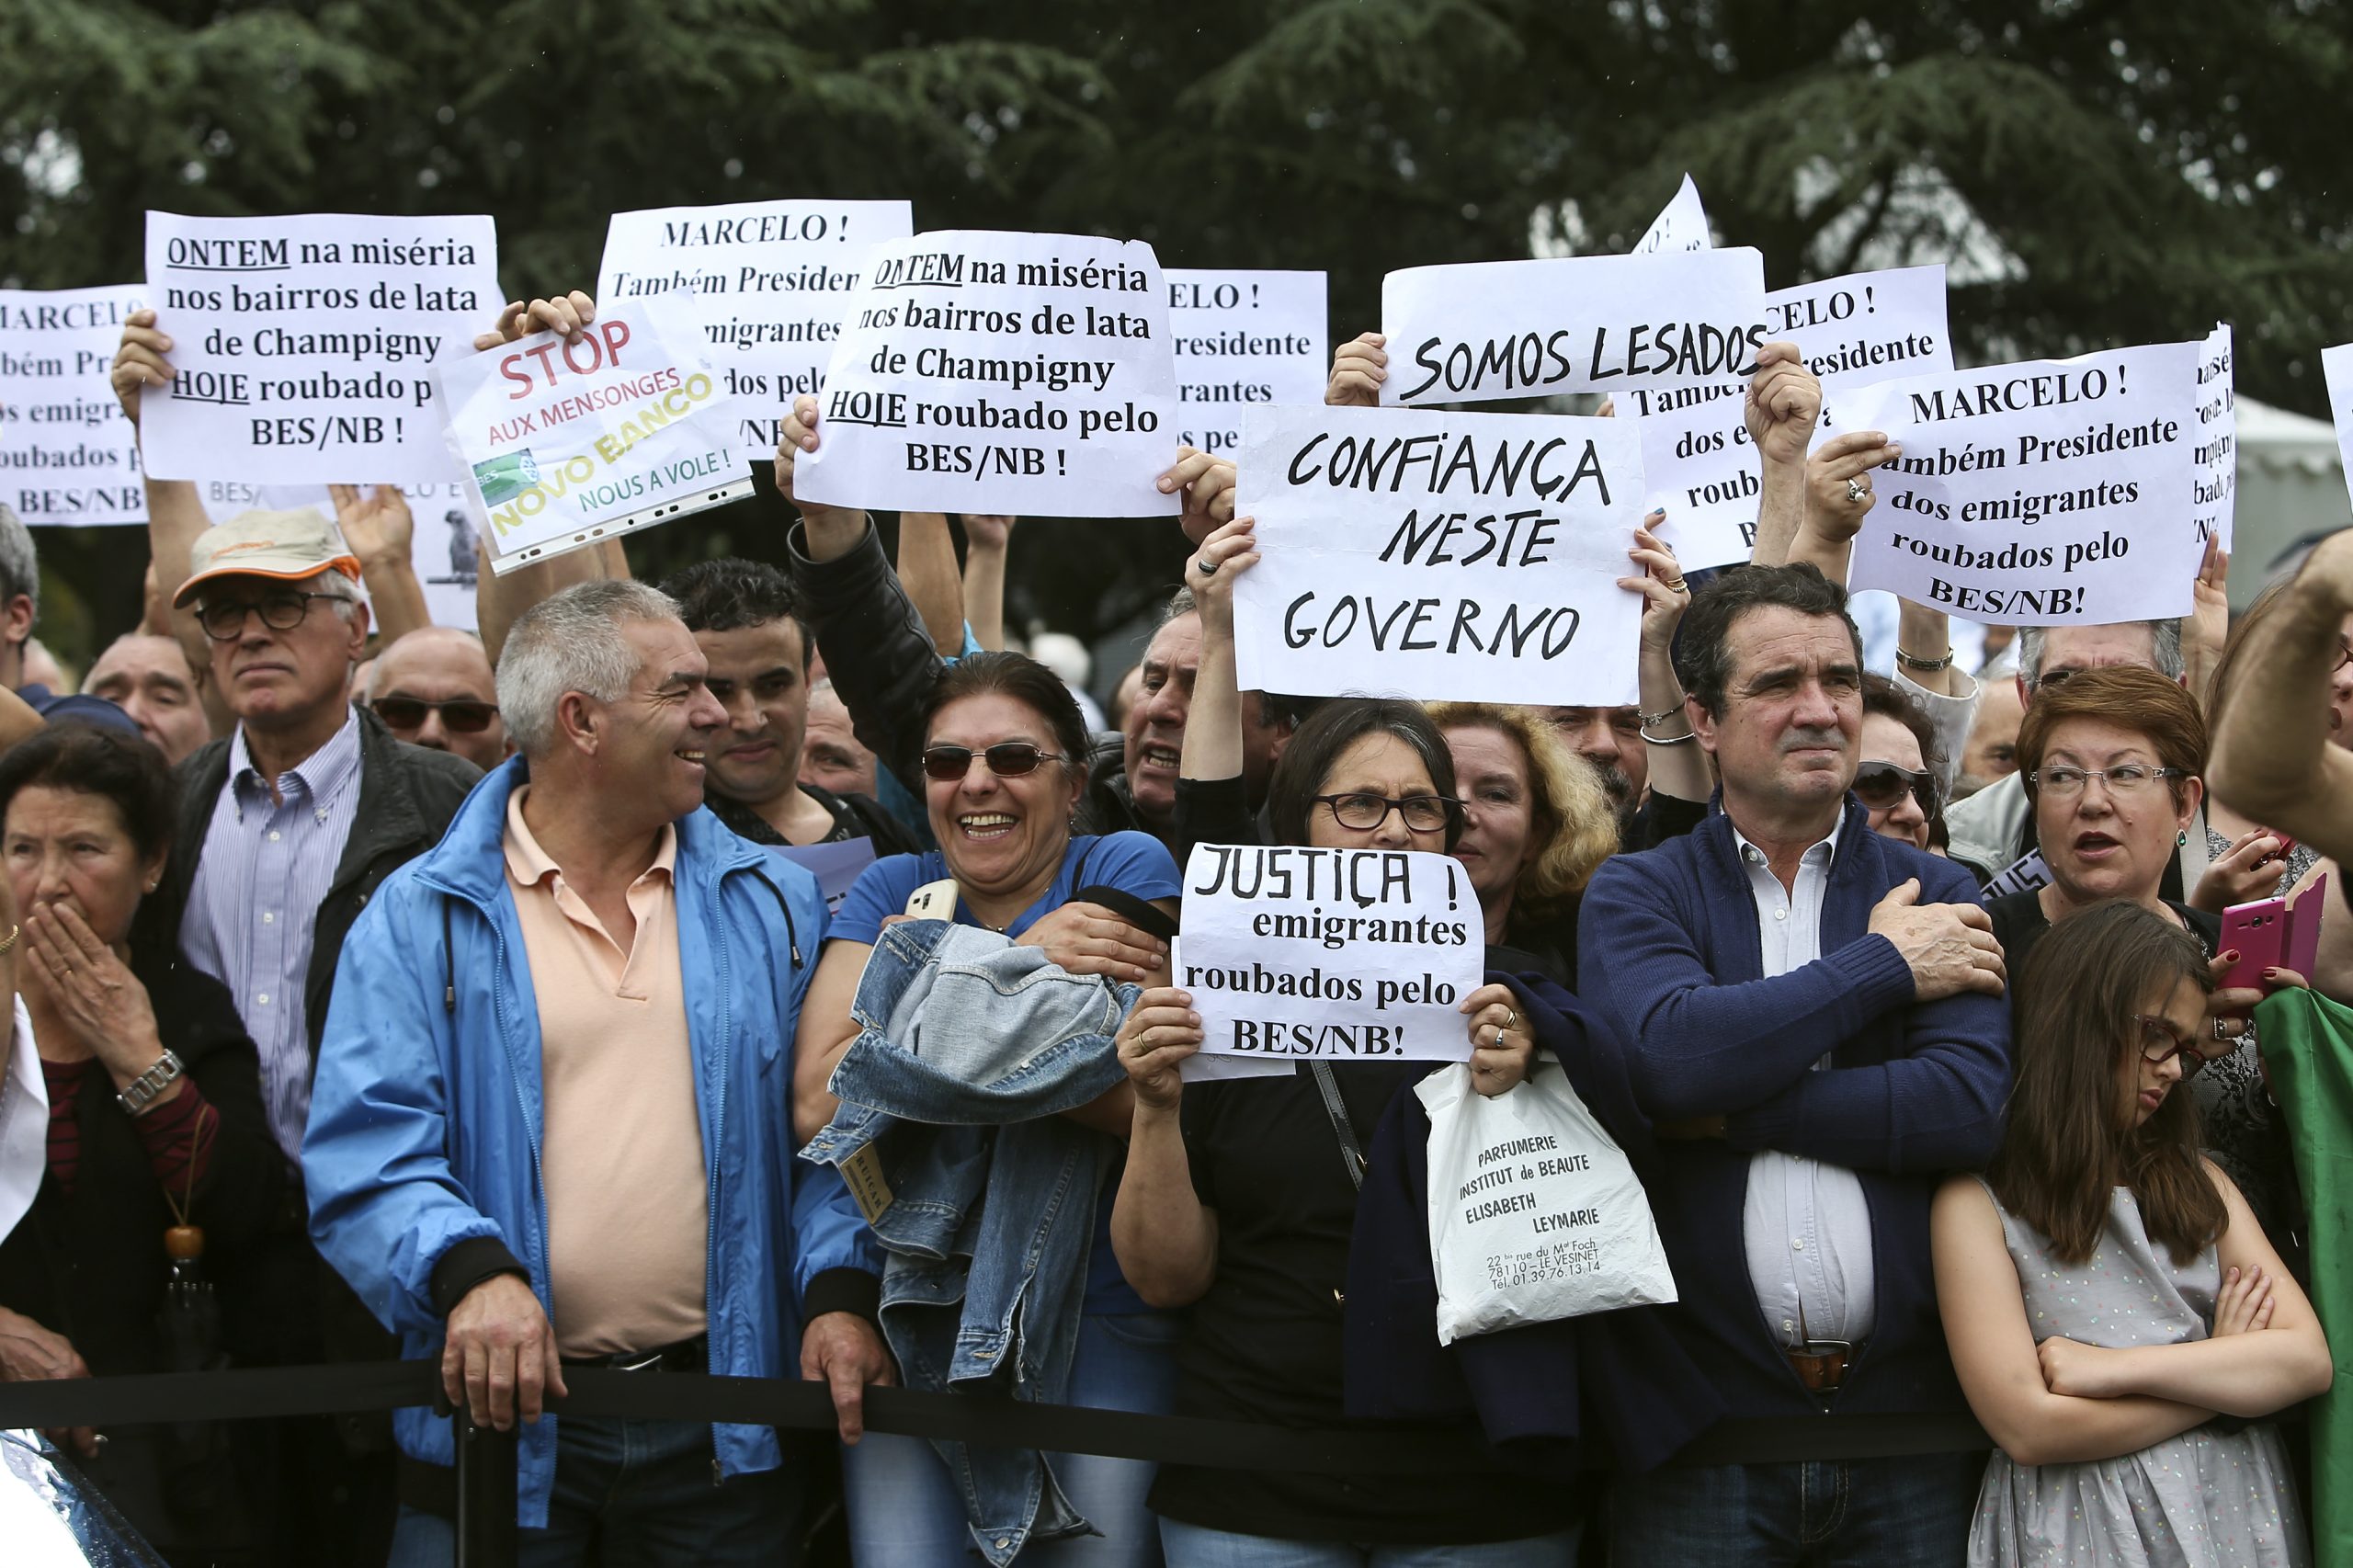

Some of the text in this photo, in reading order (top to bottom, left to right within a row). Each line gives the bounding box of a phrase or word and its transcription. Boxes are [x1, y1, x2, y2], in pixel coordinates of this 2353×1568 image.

[661, 214, 847, 247] MARCELO !
[167, 237, 475, 268] ONTEM na miséria
[612, 268, 726, 297] Também
[872, 253, 1149, 292] ONTEM na miséria
[166, 281, 478, 312] nos bairros de lata
[1252, 283, 1259, 309] !
[1866, 286, 1875, 314] !
[858, 299, 1151, 340] nos bairros de lata
[205, 326, 442, 362] de Champigny
[500, 320, 631, 400] STOP
[1399, 323, 1768, 401] SOMOS LESADOS
[172, 369, 249, 403] HOJE
[259, 370, 404, 401] roubado
[870, 345, 1115, 392] de Champigny
[489, 368, 680, 446] AUX MENSONGES
[1910, 364, 2127, 424] MARCELO !
[251, 416, 403, 450] BES/NB !
[826, 391, 906, 428] HOJE
[915, 397, 1068, 432] roubado
[1079, 402, 1158, 439] pelo
[491, 373, 713, 537] NOVO BANCO
[1676, 430, 1724, 459] dos
[2017, 416, 2178, 466] Presidente
[579, 449, 732, 513] NOUS A VOLE !
[906, 443, 1065, 482] BES/NB !
[1892, 480, 2139, 525] dos emigrantes
[1380, 509, 1560, 567] NESTE
[1893, 530, 2129, 573] roubados pelo
[1927, 576, 2086, 615] BES/NB!
[1283, 590, 1580, 661] GOVERNO
[1447, 865, 1456, 911] !
[1253, 907, 1466, 949] emigrantes
[1186, 962, 1456, 1010] roubados pelo
[1232, 1019, 1404, 1056] BES/NB!
[1478, 1135, 1558, 1167] PARFUMERIE
[1460, 1154, 1590, 1200] INSTITUT de BEAUTE
[1465, 1192, 1537, 1224] ELISABETH
[1532, 1208, 1600, 1234] LEYMARIE
[1487, 1256, 1501, 1267] 22
[1516, 1252, 1532, 1261] rue
[1536, 1245, 1549, 1258] du
[1572, 1237, 1596, 1251] Foch
[1489, 1261, 1527, 1279] 78110
[1540, 1257, 1551, 1268] LE
[1554, 1249, 1599, 1267] VESINET
[1492, 1260, 1601, 1290] Tél. 01.39.76.13.14
